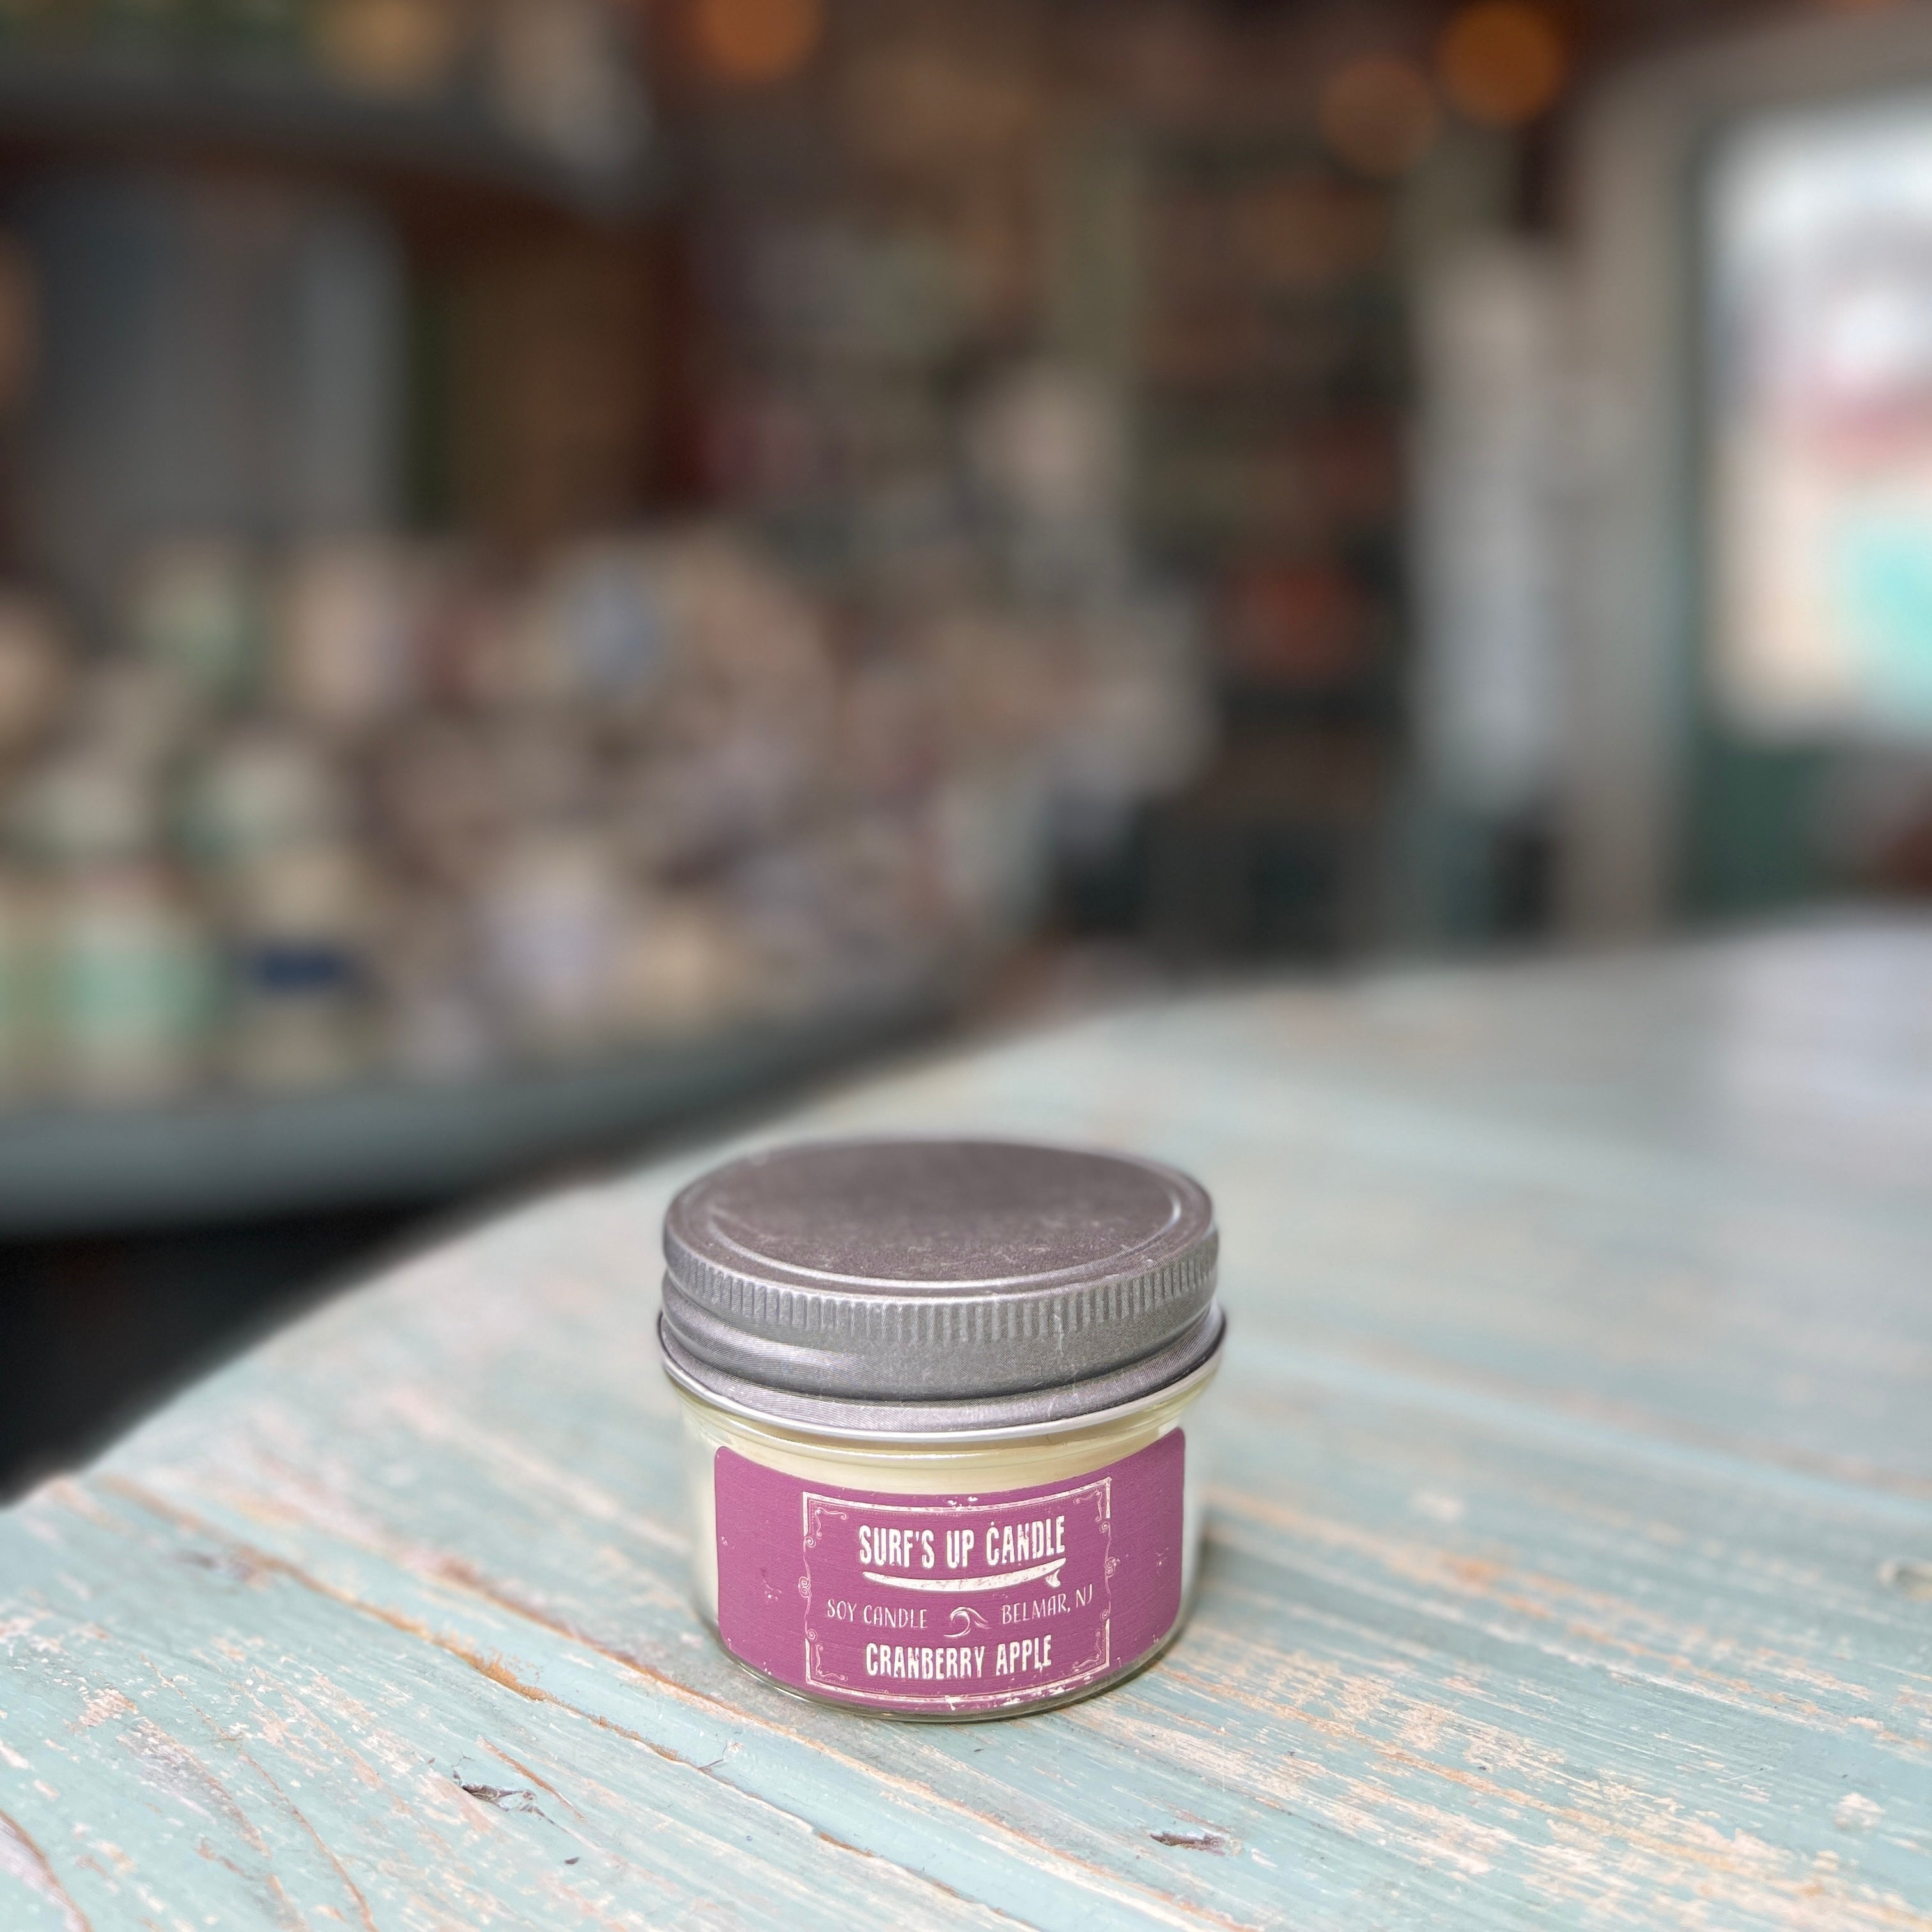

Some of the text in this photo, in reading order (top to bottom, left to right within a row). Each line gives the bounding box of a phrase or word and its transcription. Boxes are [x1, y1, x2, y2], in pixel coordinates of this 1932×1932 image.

[859, 1515, 1066, 1569] SURF'S UP CANDLE
[827, 1599, 928, 1629] SOY CANDLE
[1001, 1583, 1094, 1624] BELMAR, NJ
[865, 1634, 1052, 1680] CRANBERRY APPLE
